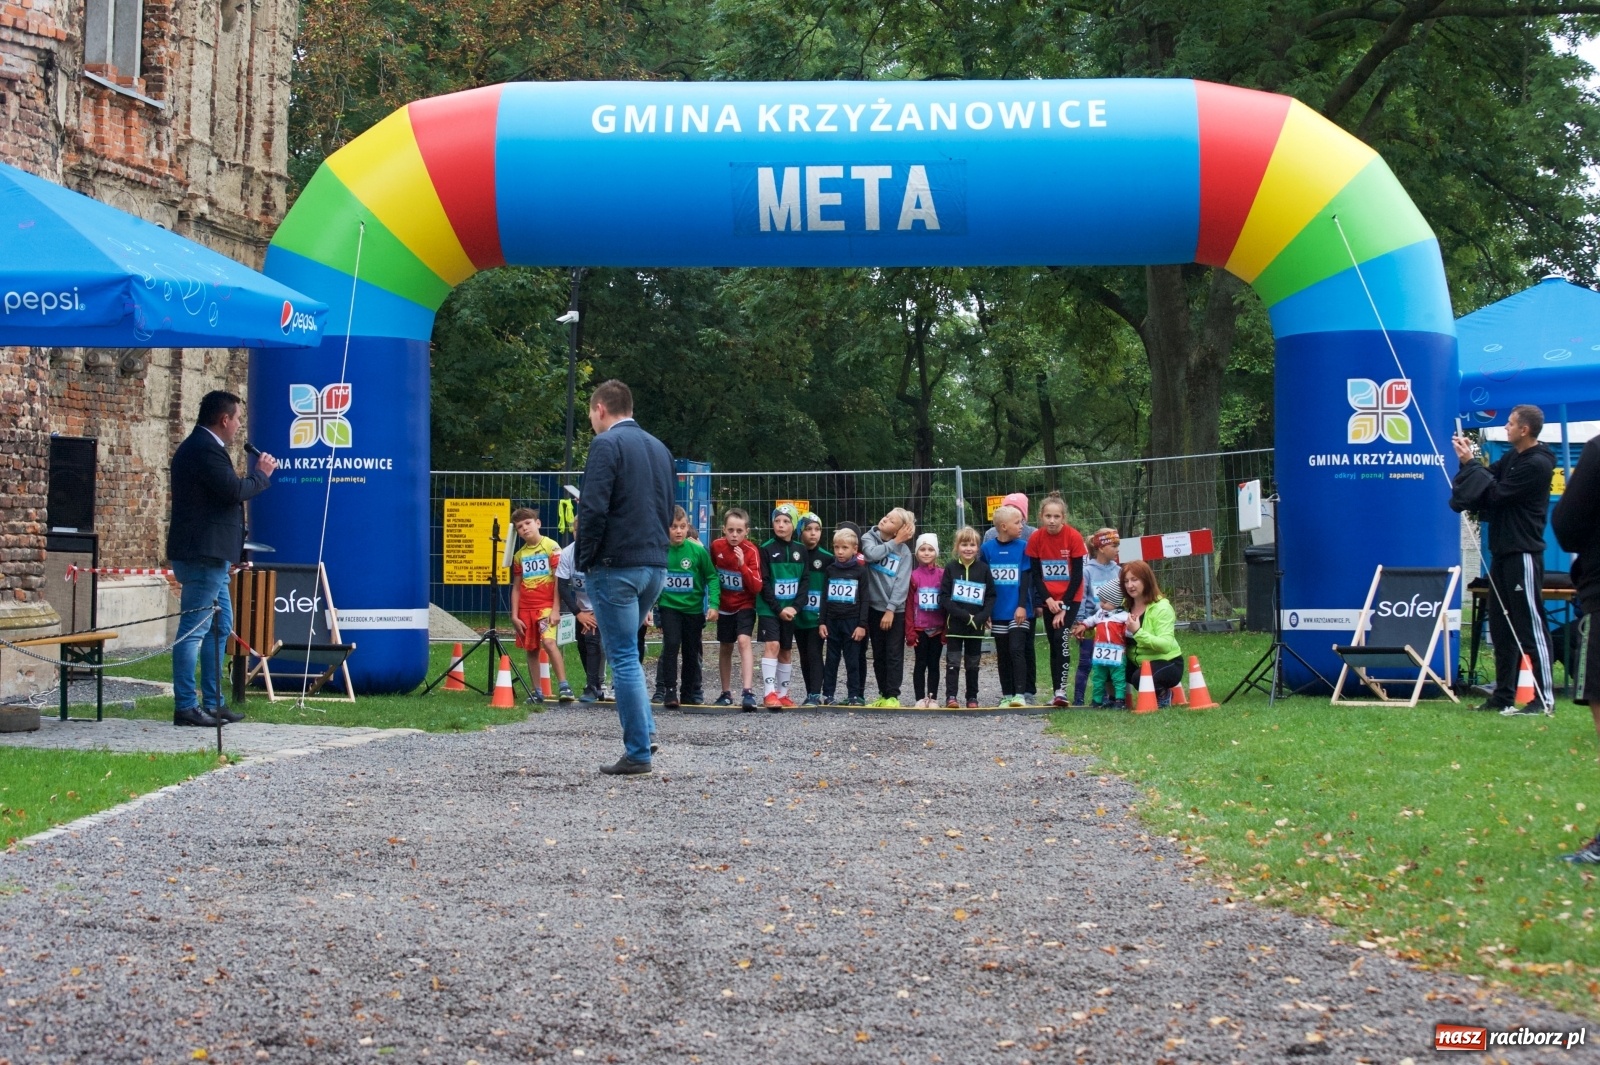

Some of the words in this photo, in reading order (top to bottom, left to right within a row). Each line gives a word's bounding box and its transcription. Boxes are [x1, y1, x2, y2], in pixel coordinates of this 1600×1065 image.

[591, 104, 742, 134] GMINA
[757, 97, 1108, 132] KRZYŻANOWICE
[757, 164, 940, 231] META
[291, 311, 317, 334] pepsi
[294, 455, 393, 470] KRZYŻANOWICE
[1308, 453, 1350, 467] GMINA
[1353, 450, 1445, 466] KRZYŻANOWICE
[301, 476, 323, 484] poznaj
[1334, 472, 1357, 480] odkryj
[1361, 472, 1384, 480] poznaj
[1389, 471, 1425, 480] zapamiętaj
[524, 559, 546, 573] 303
[1045, 564, 1067, 576] 322
[719, 574, 740, 587] 316
[992, 568, 1016, 580] 320
[666, 577, 691, 588] 304
[778, 583, 796, 595] 311
[830, 584, 853, 597] 302
[956, 585, 980, 599] 315
[274, 589, 321, 613] afer
[1377, 593, 1442, 618] safer
[1095, 648, 1118, 660] 321
